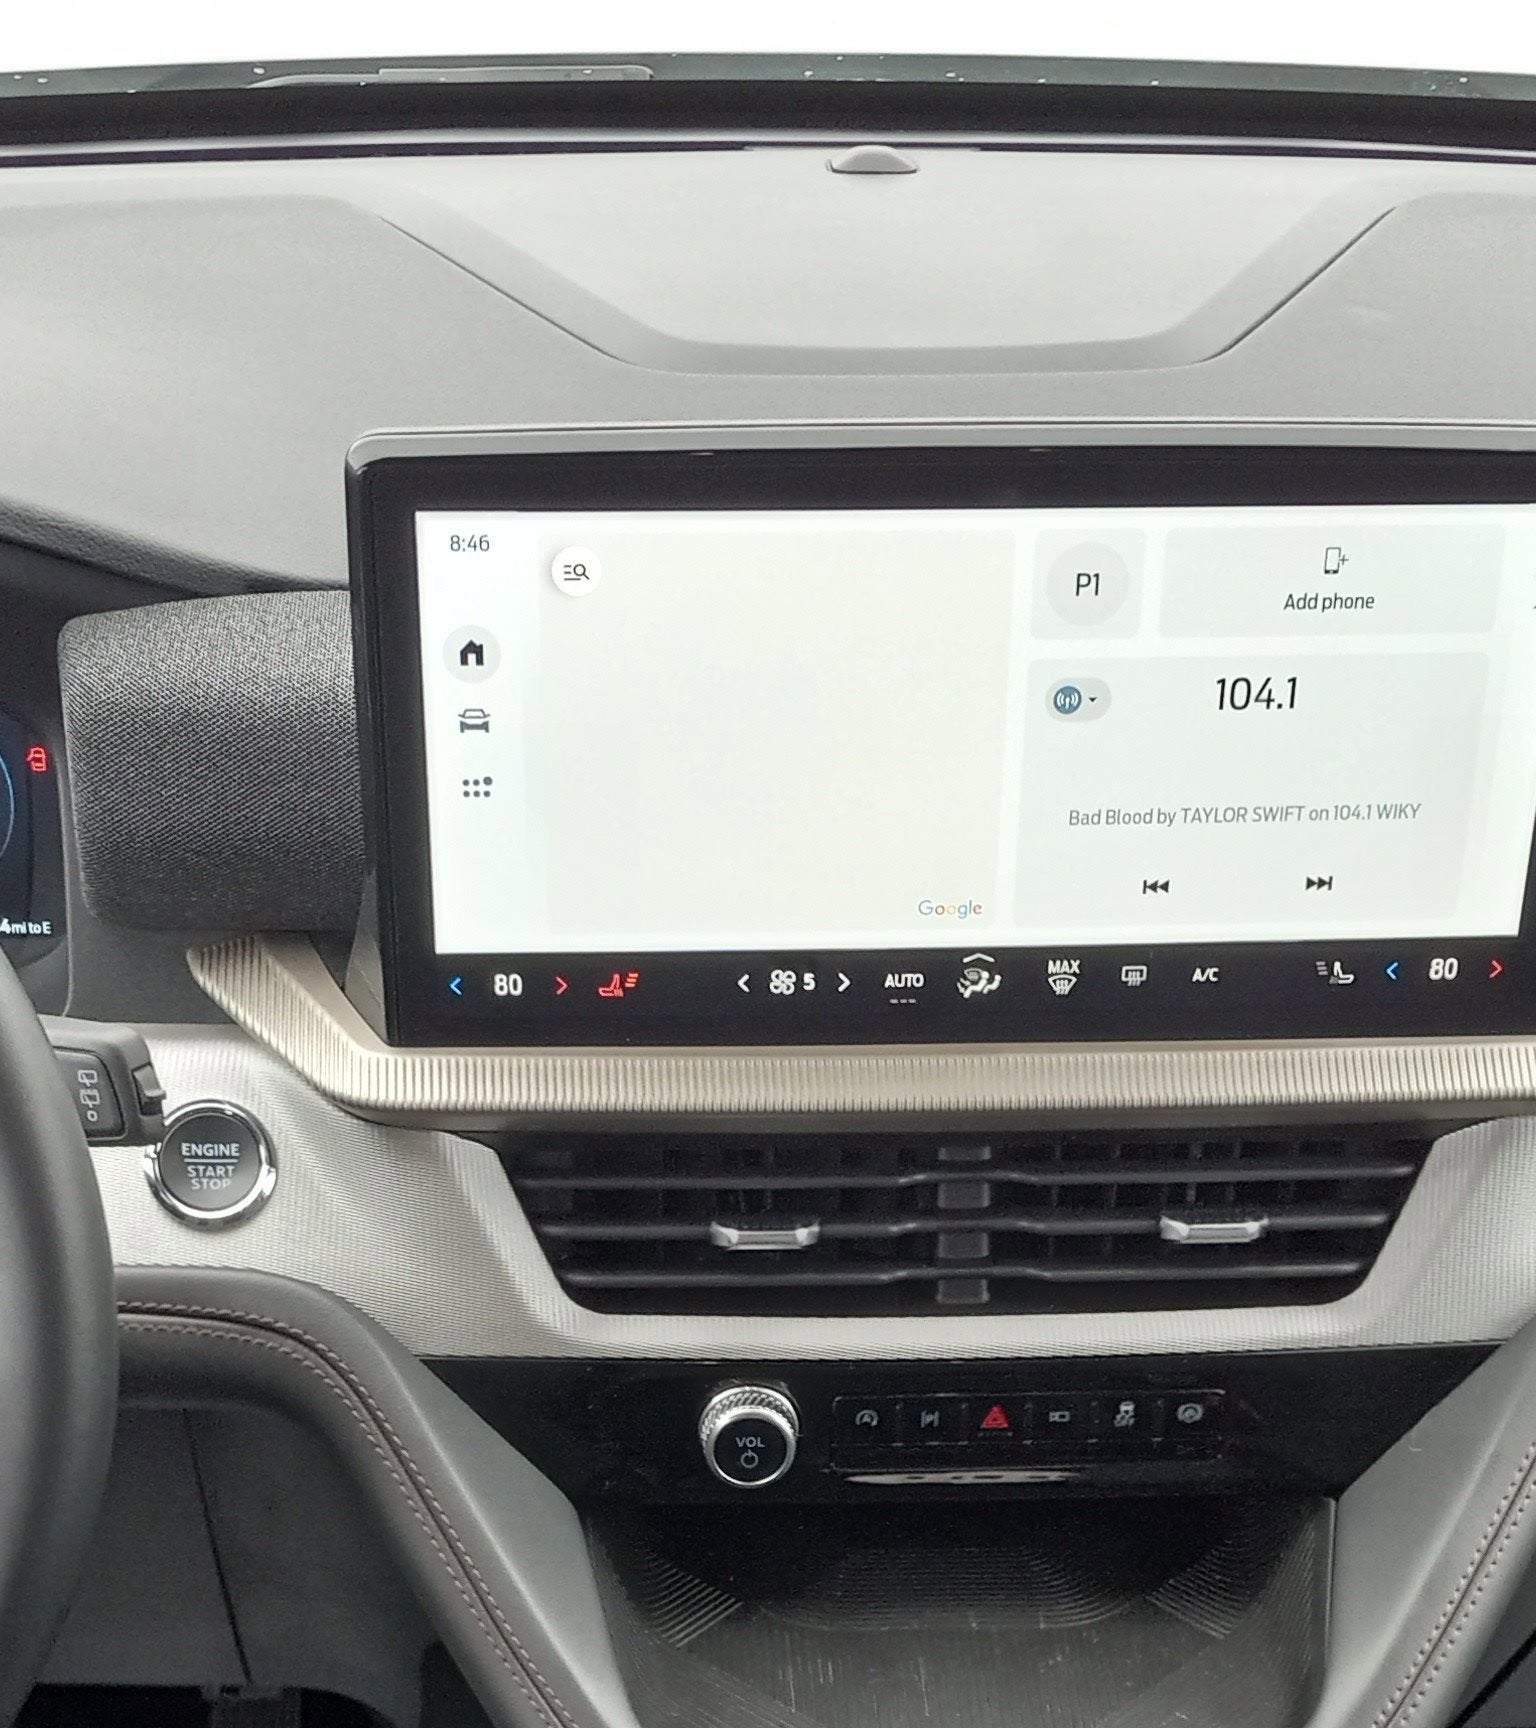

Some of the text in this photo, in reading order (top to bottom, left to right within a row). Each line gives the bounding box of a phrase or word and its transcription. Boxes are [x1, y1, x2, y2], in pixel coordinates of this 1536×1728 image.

[449, 534, 491, 553] 8:46
[1074, 572, 1101, 597] P1
[1283, 592, 1375, 614] Add phone
[1215, 677, 1298, 711] 104.1
[1068, 803, 1422, 828] Bad Blood by TAYLOR SWIFT on 104.1 WIKY
[917, 899, 983, 919] Google
[1047, 959, 1081, 976] MAX
[1191, 966, 1220, 983] A/C
[1428, 957, 1459, 980] 80
[493, 972, 524, 996] 80
[802, 973, 816, 992] 5
[883, 972, 924, 989] AUTO
[180, 1143, 240, 1157] ENGINE
[187, 1165, 235, 1178] START
[191, 1178, 232, 1191] STOP
[735, 1436, 766, 1449] VOL
